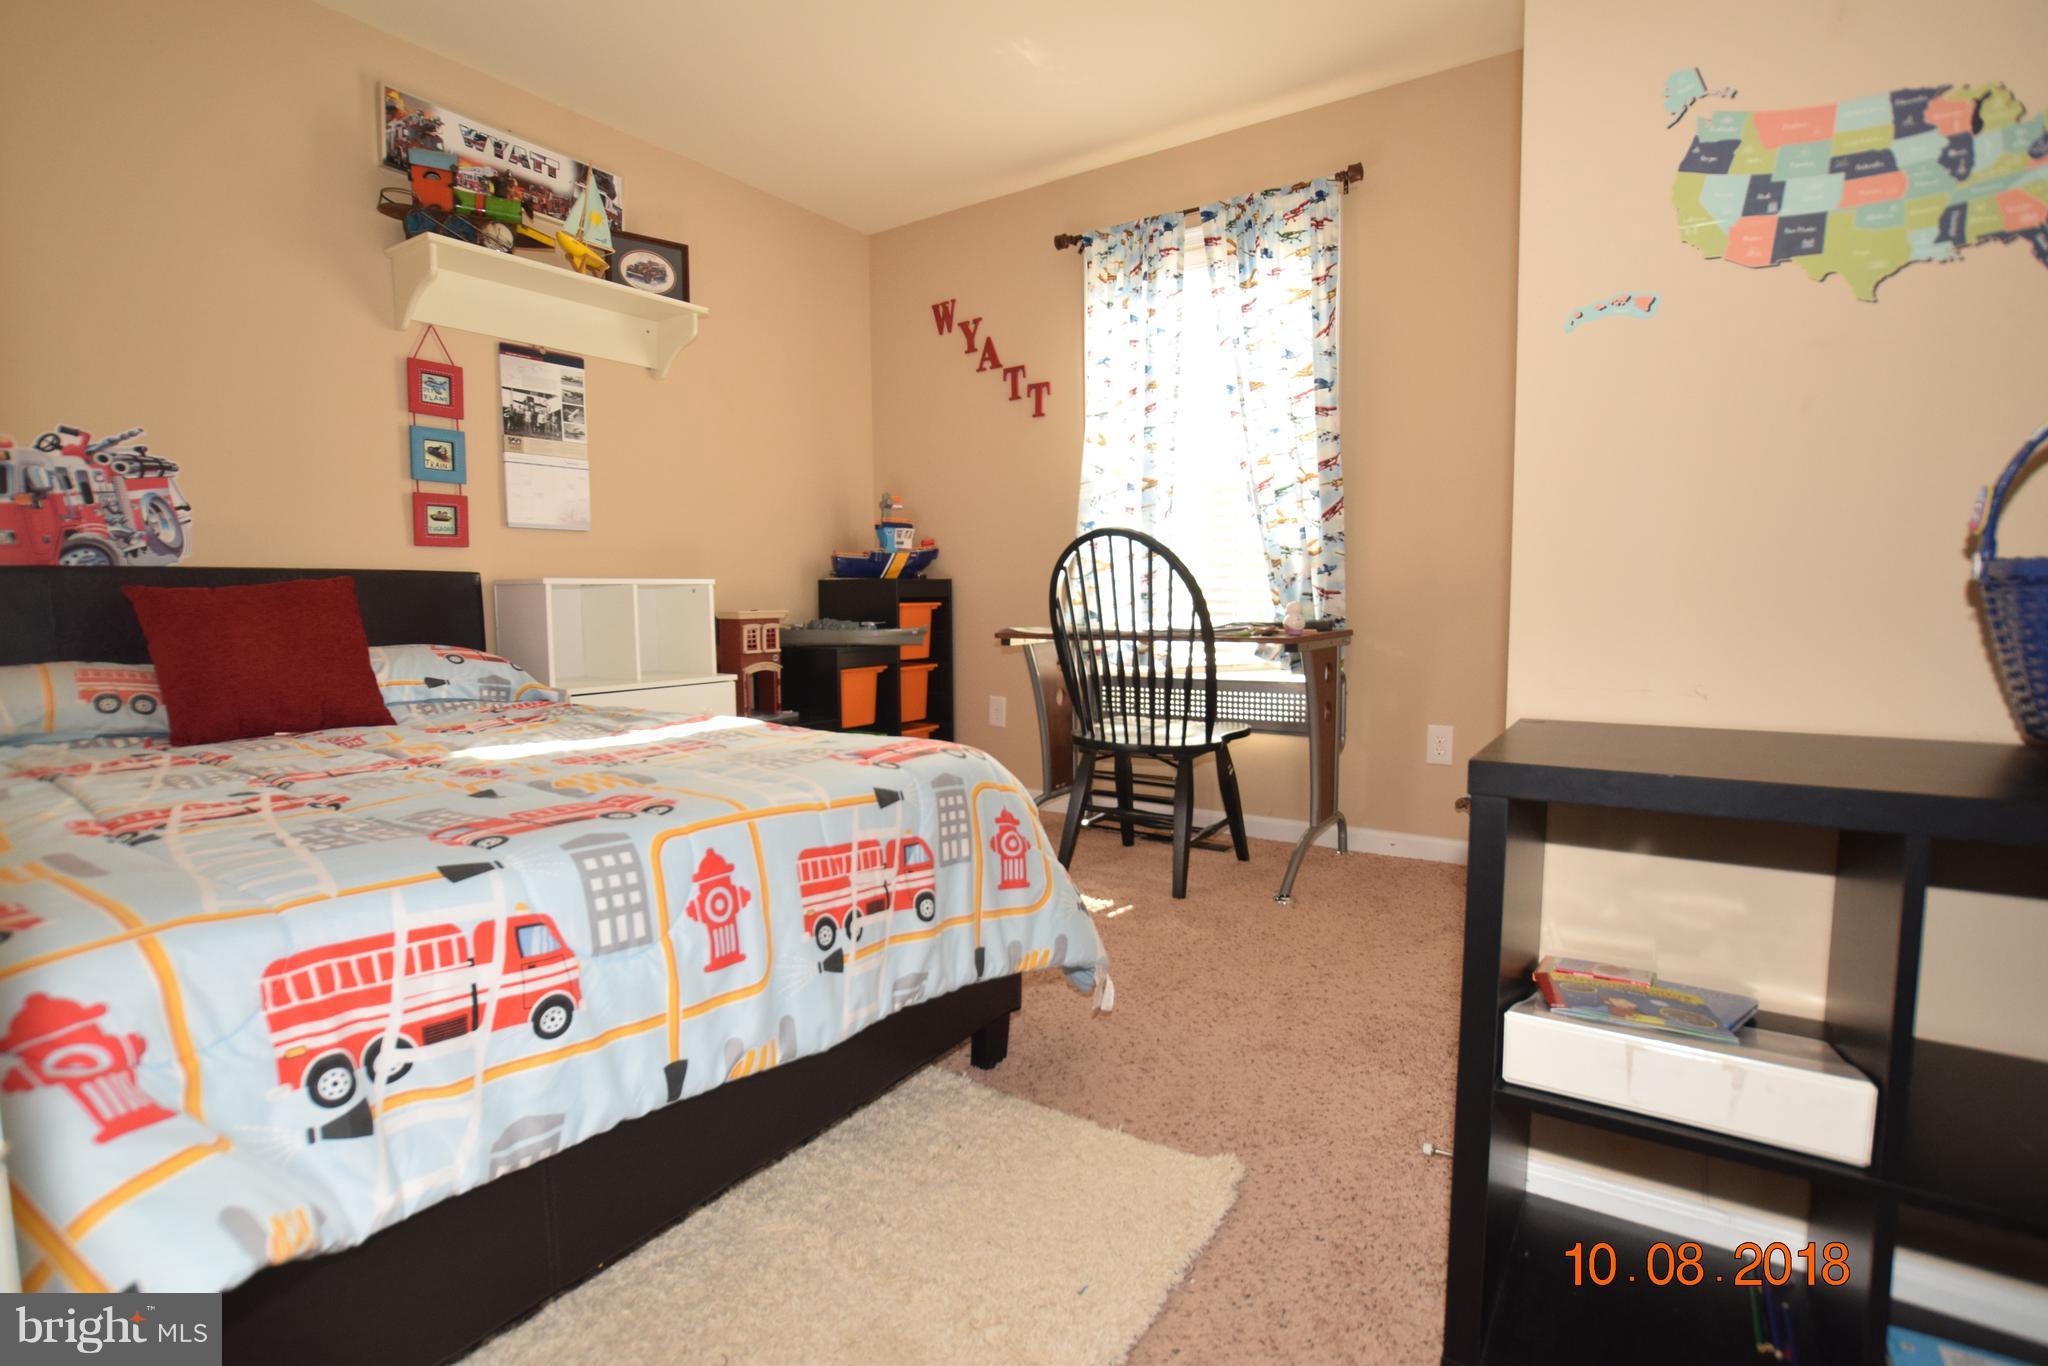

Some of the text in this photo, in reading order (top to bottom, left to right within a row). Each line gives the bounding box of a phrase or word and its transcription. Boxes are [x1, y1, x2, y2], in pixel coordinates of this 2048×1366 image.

[459, 123, 560, 179] WYATT
[931, 298, 1051, 418] WYATT
[426, 459, 448, 469] TRAIN
